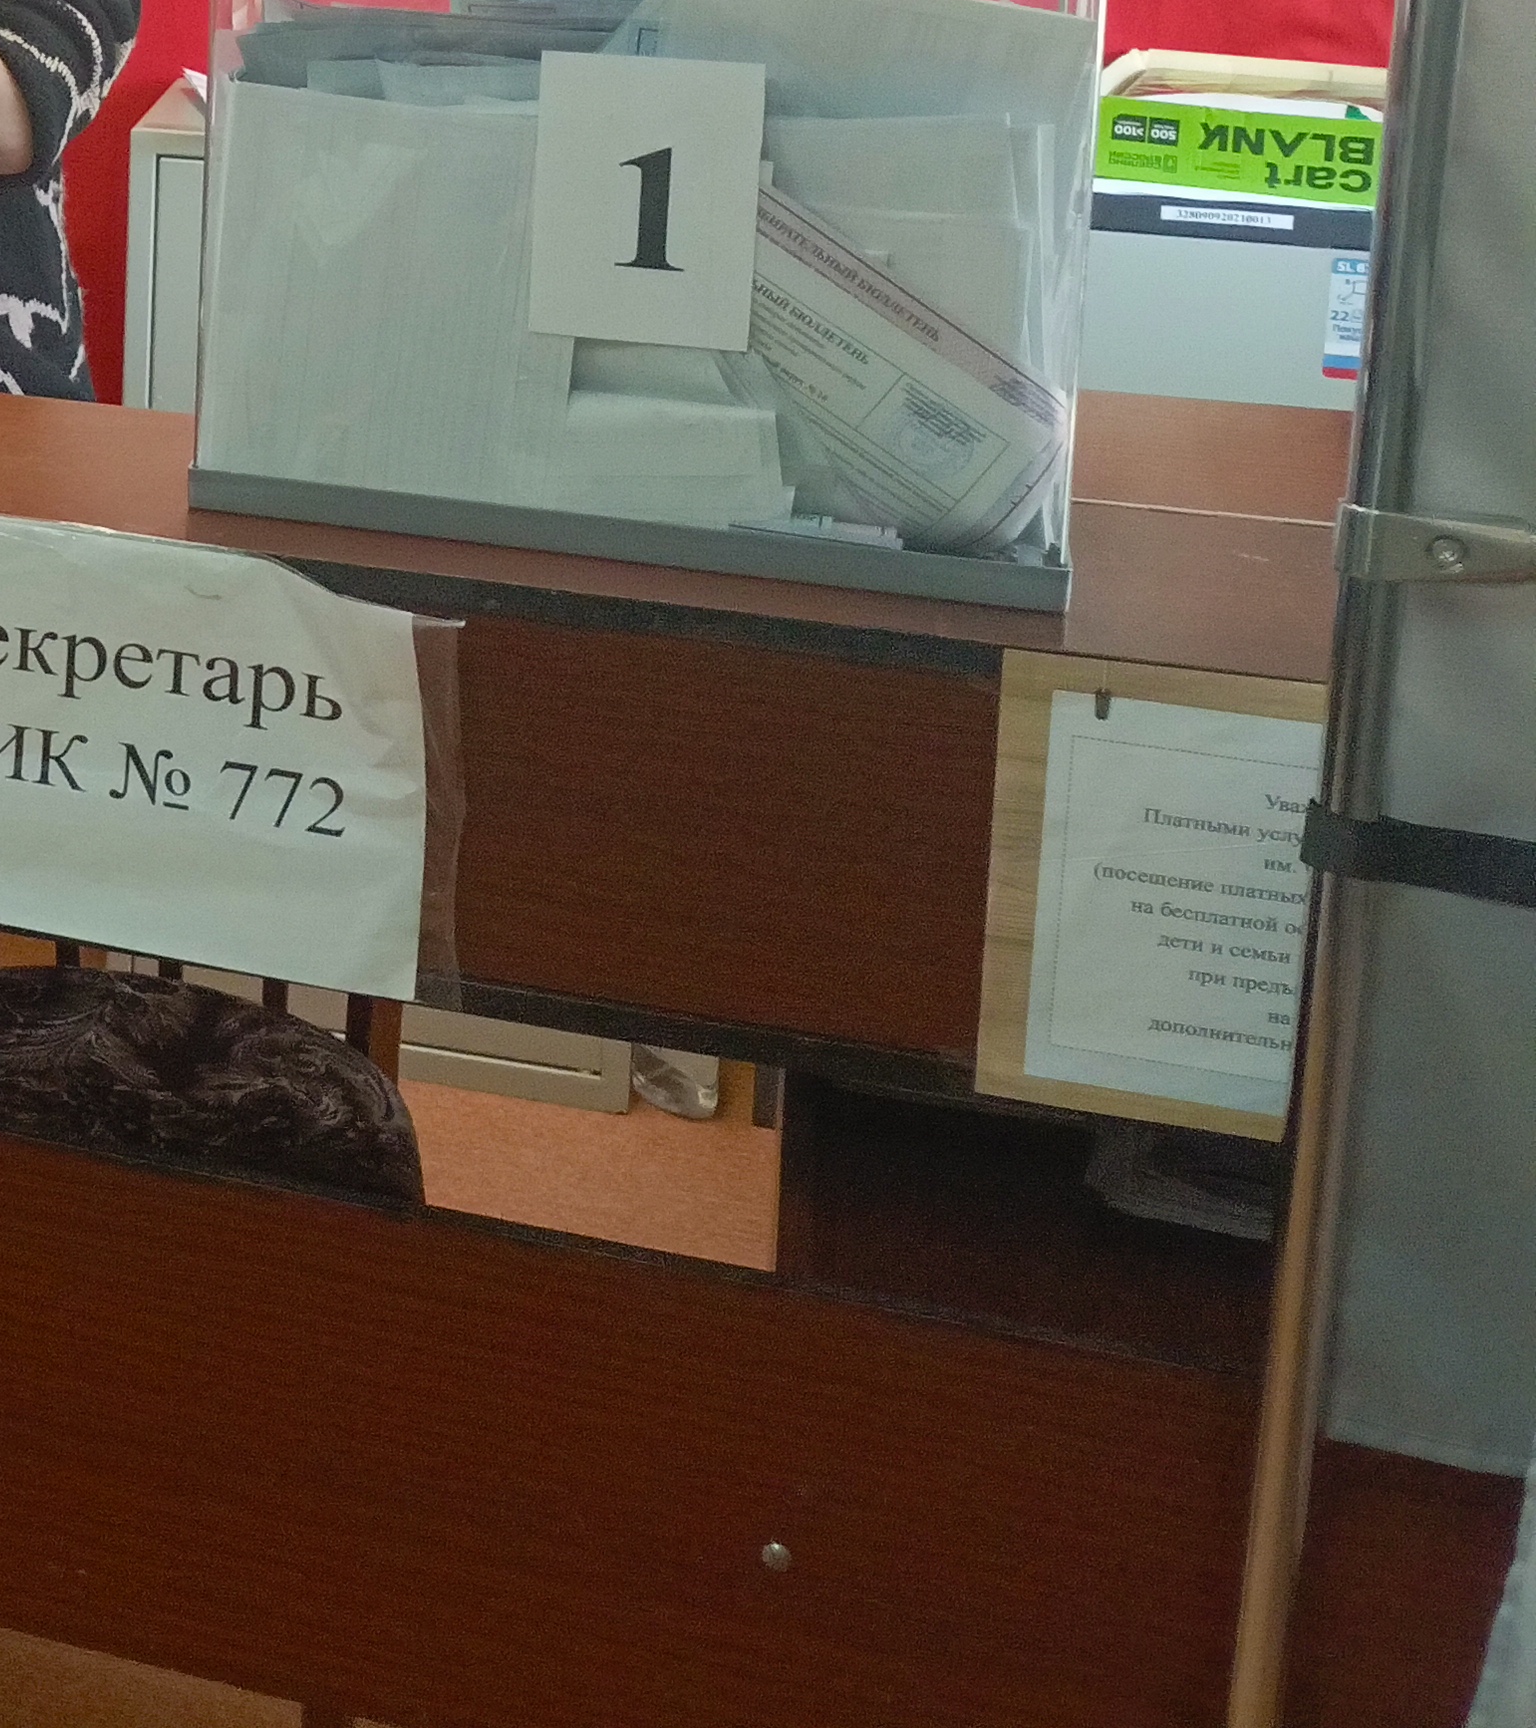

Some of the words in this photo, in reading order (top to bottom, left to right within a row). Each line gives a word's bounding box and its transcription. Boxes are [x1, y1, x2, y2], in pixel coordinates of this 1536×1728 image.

[1149, 128, 1178, 141] 500
[1197, 121, 1376, 167] BLANK
[1263, 161, 1373, 194] cart
[611, 145, 686, 274] 1
[1330, 310, 1350, 322] 22
[108, 740, 192, 811] №
[218, 759, 347, 838] 772
[1143, 807, 1251, 838] Платными
[1093, 862, 1215, 893] (посещение
[1219, 881, 1308, 906] платных
[1130, 900, 1154, 915] на
[1160, 901, 1278, 933] бесплатной
[1157, 934, 1204, 953] дети
[1211, 942, 1224, 956] и
[1228, 944, 1292, 965] семьи
[1187, 969, 1227, 988] при
[1267, 1010, 1292, 1026] на
[1147, 1017, 1293, 1053] дополнительн
